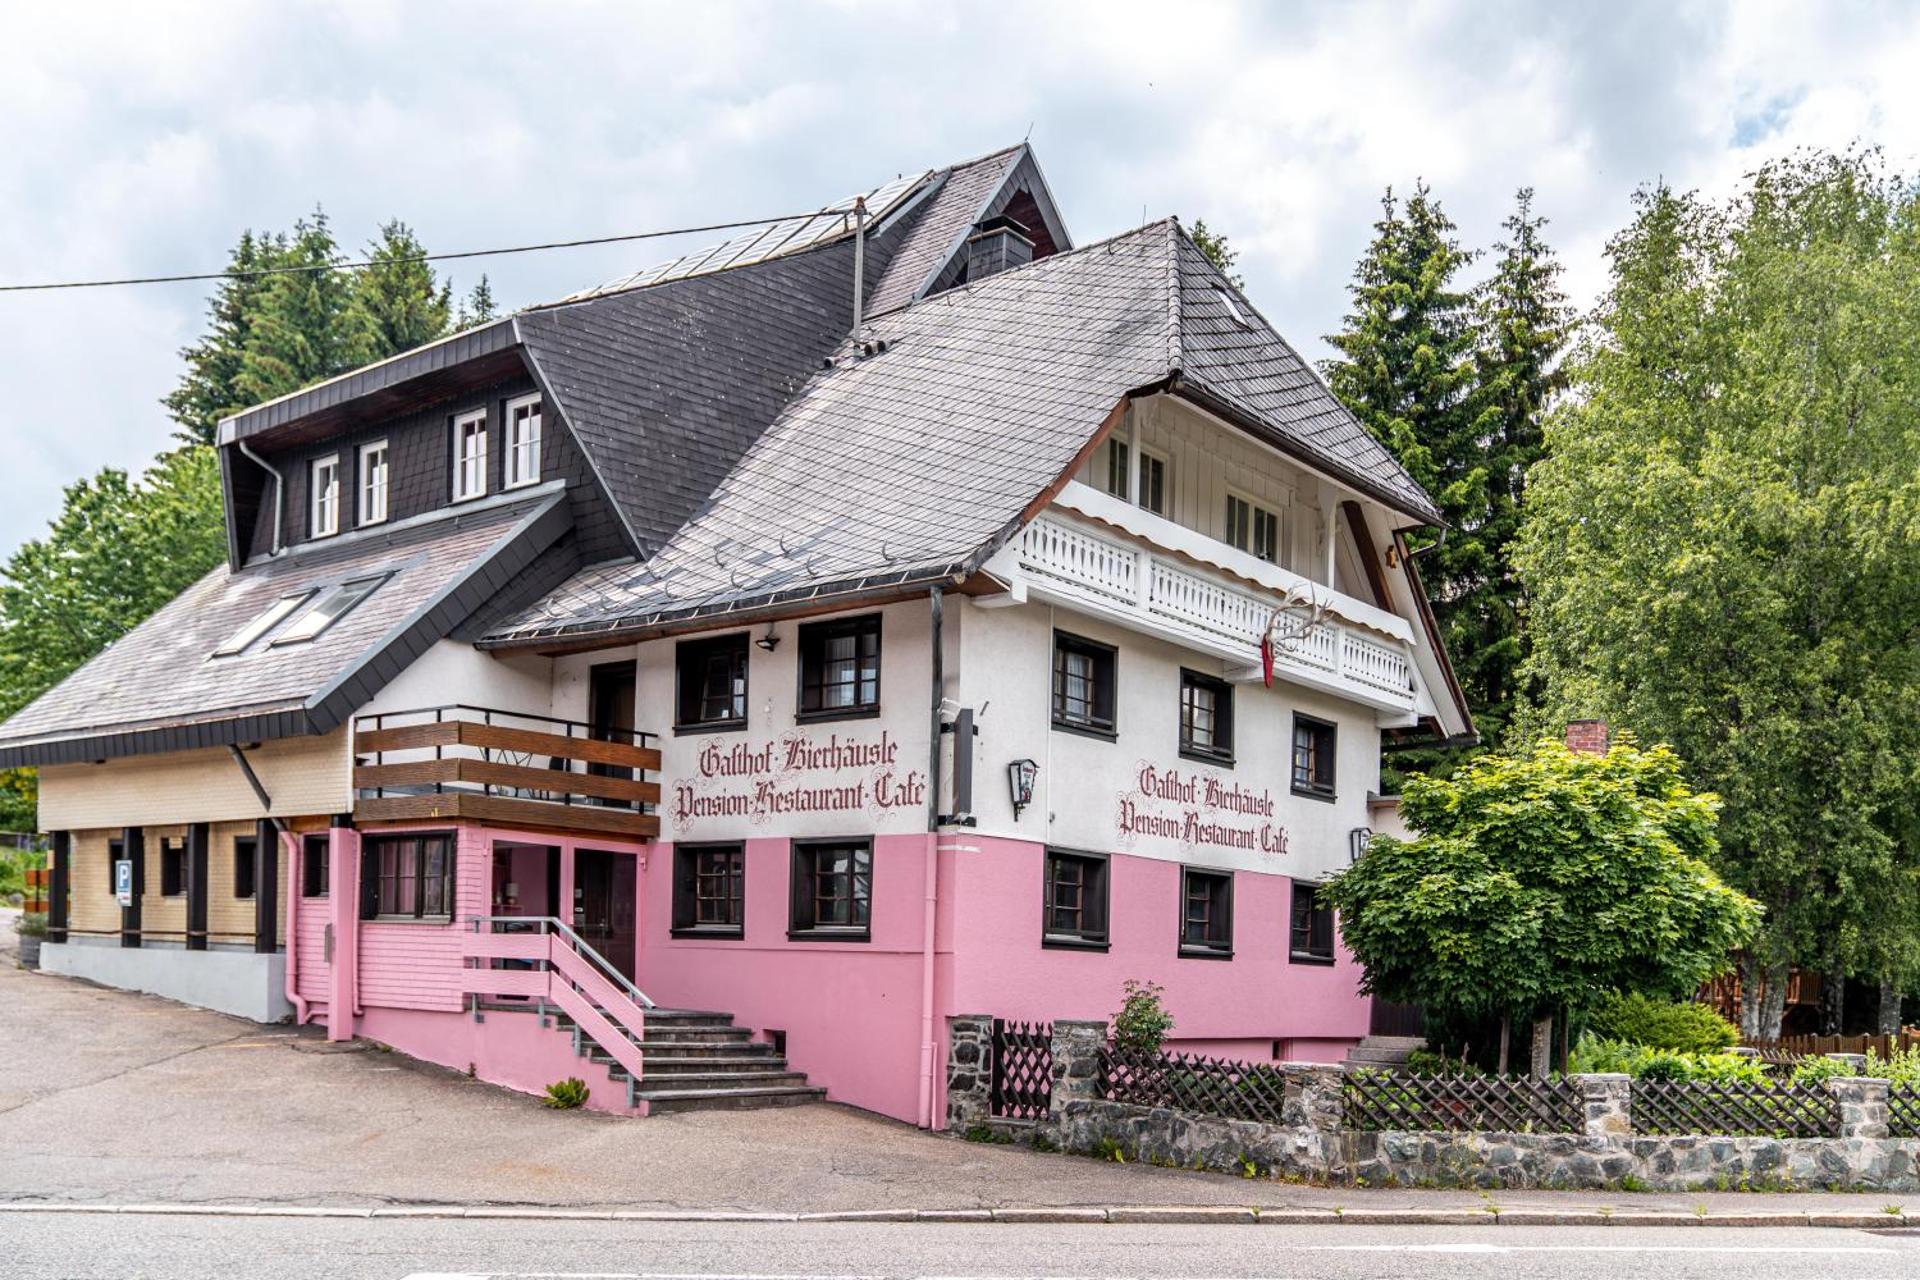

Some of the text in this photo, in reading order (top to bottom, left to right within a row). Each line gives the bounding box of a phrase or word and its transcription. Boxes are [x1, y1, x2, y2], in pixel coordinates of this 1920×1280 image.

[782, 731, 898, 773] Bierhäusle
[675, 770, 926, 821] Pension Restaurant Café
[1203, 777, 1274, 818] Bierhäusle
[1119, 798, 1289, 855] Pension Restaurant Café
[119, 864, 129, 888] P
